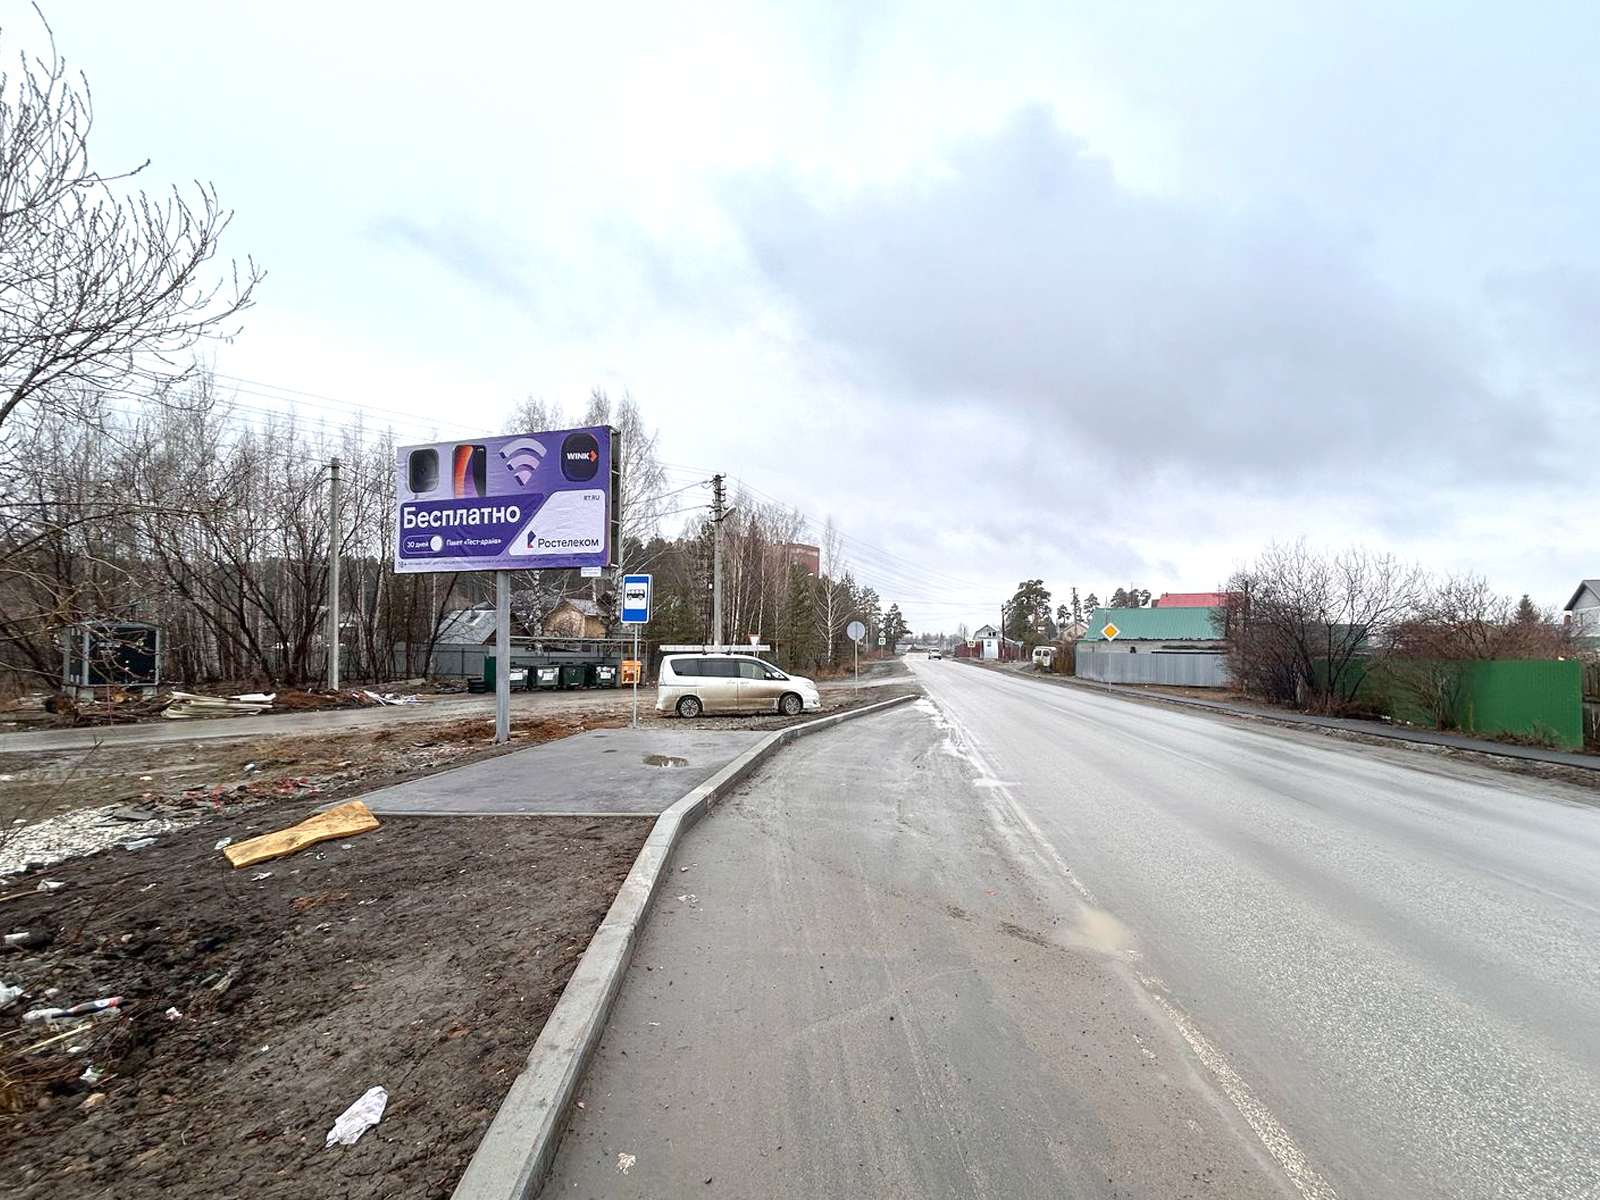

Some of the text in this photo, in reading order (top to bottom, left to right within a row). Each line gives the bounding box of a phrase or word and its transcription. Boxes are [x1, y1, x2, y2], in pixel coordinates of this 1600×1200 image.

[567, 452, 590, 461] WINK
[403, 505, 521, 529] Бесплатно
[406, 541, 429, 549] 30 дней
[538, 538, 599, 548] Ростелеком
